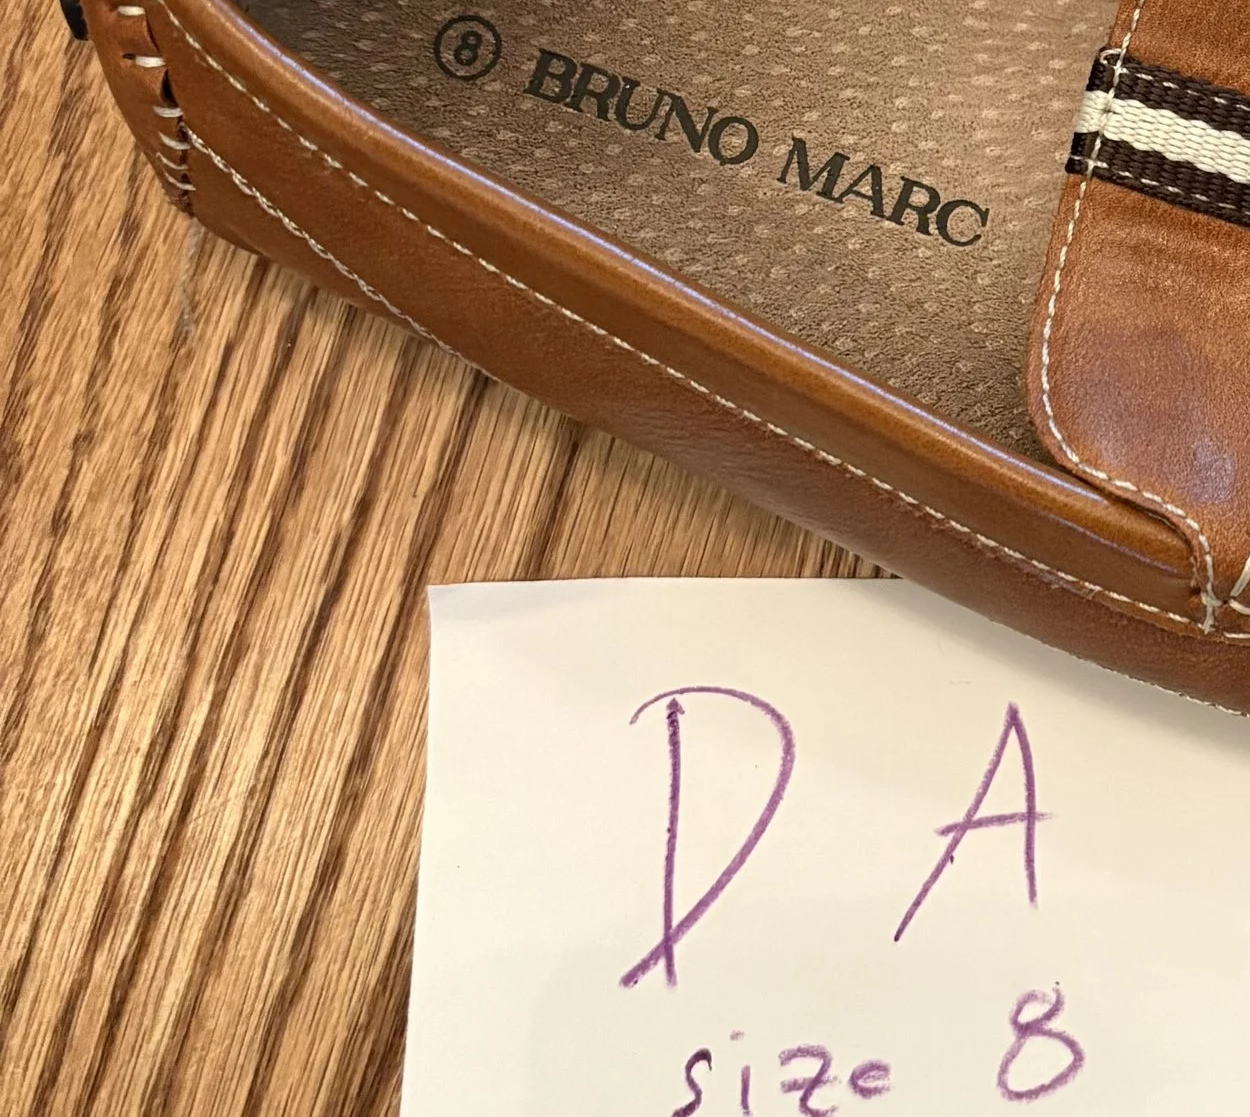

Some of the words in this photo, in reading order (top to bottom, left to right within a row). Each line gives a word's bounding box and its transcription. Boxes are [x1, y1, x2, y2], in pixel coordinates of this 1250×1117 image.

[522, 47, 760, 166] BRUNO
[776, 135, 990, 247] MARC
[618, 685, 796, 989] D
[893, 701, 1054, 943] A
[670, 1029, 892, 1117] size
[996, 979, 1085, 1102] 8
